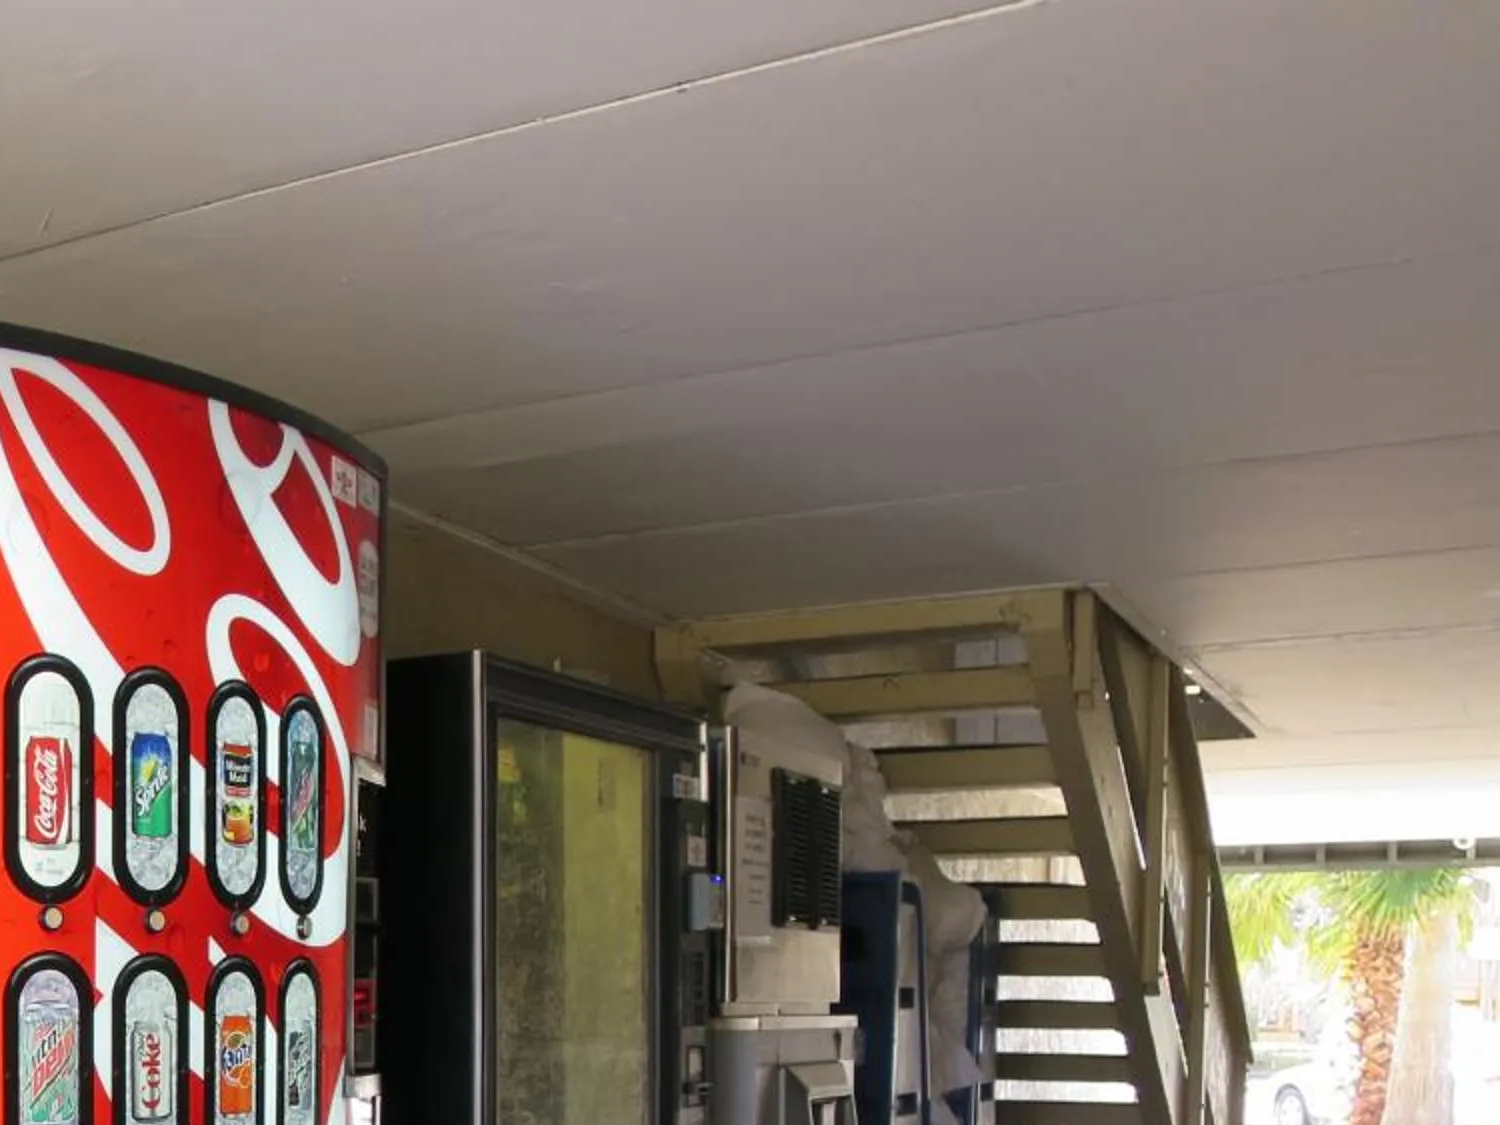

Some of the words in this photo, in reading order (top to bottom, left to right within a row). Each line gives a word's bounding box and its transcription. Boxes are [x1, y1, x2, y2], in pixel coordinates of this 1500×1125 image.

[34, 745, 59, 839] Coca-Cola
[134, 765, 171, 817] Sprite
[141, 1032, 161, 1110] Coke
